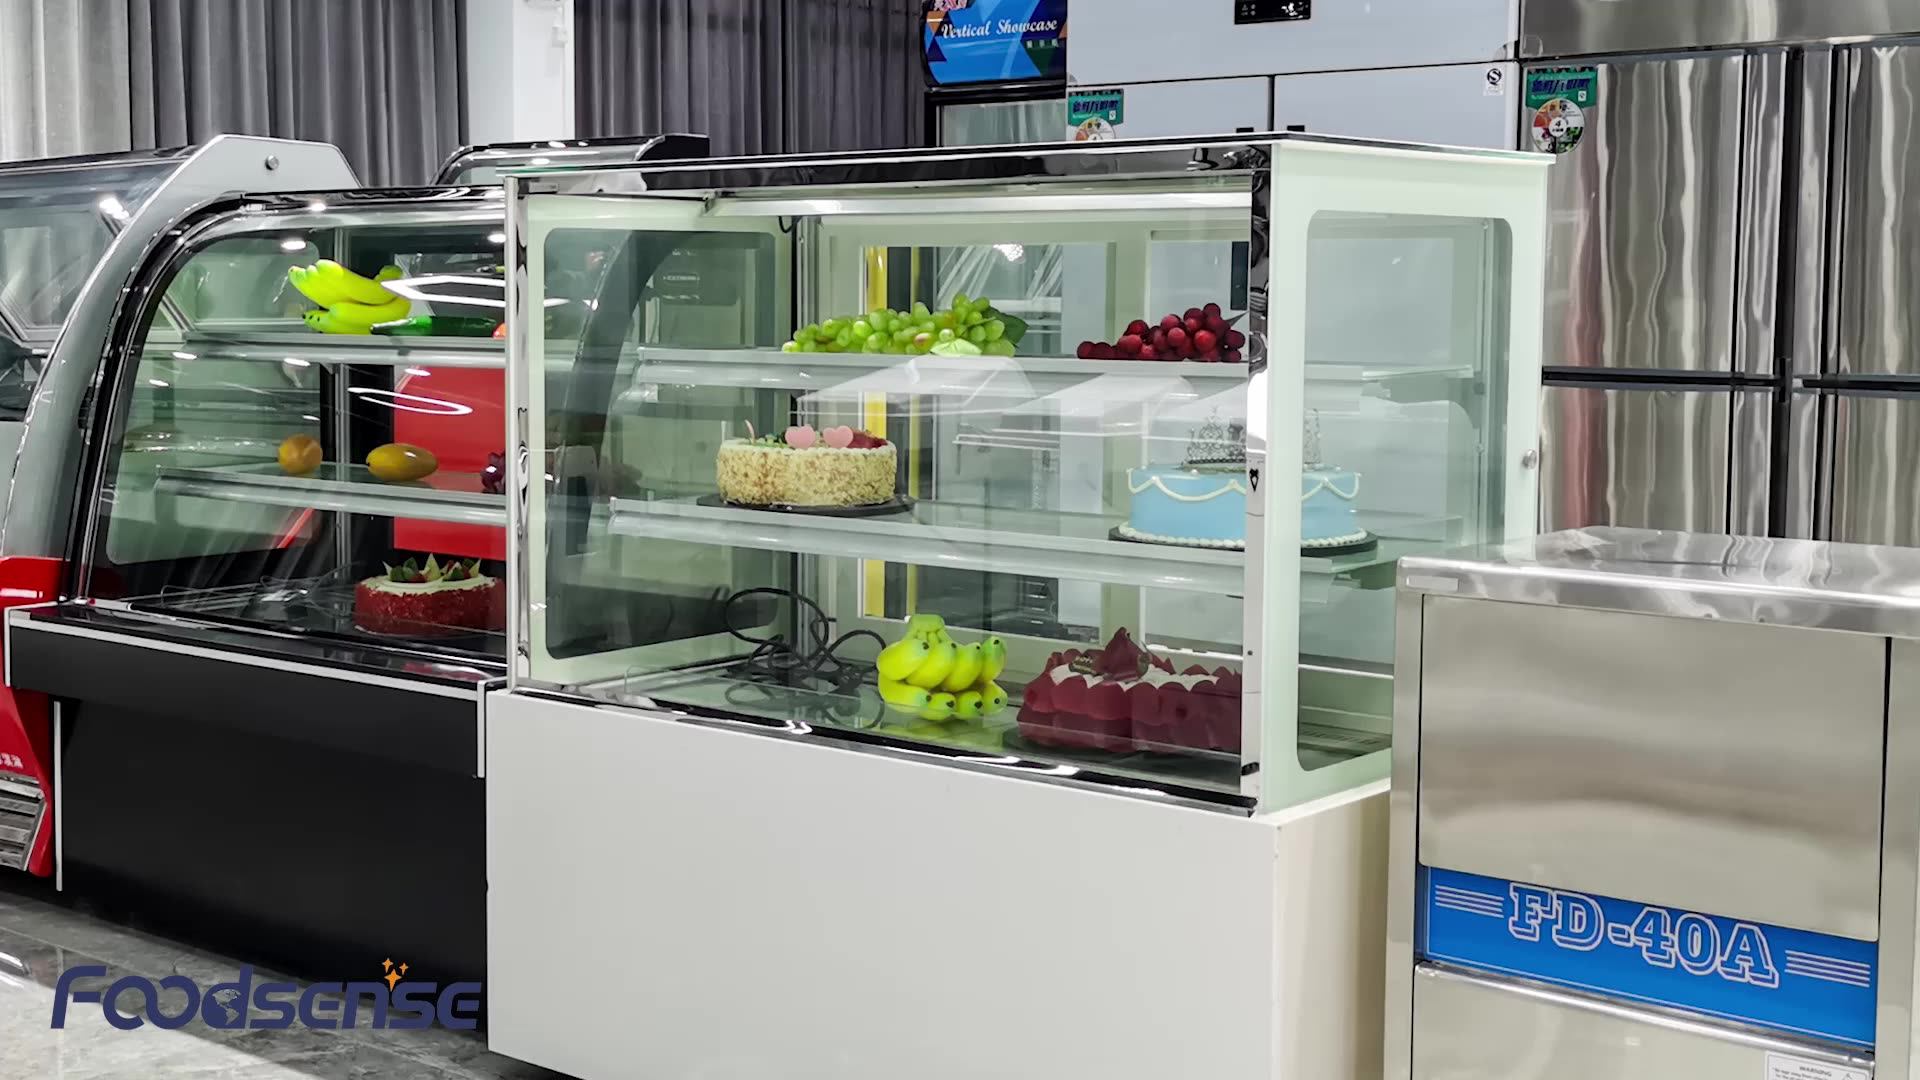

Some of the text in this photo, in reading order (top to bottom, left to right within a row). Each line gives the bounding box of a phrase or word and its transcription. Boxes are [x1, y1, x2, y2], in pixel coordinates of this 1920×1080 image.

[941, 19, 1058, 39] Vertical Showcase
[1508, 882, 1780, 989] FD-40A
[1799, 1066, 1832, 1077] WARNING
